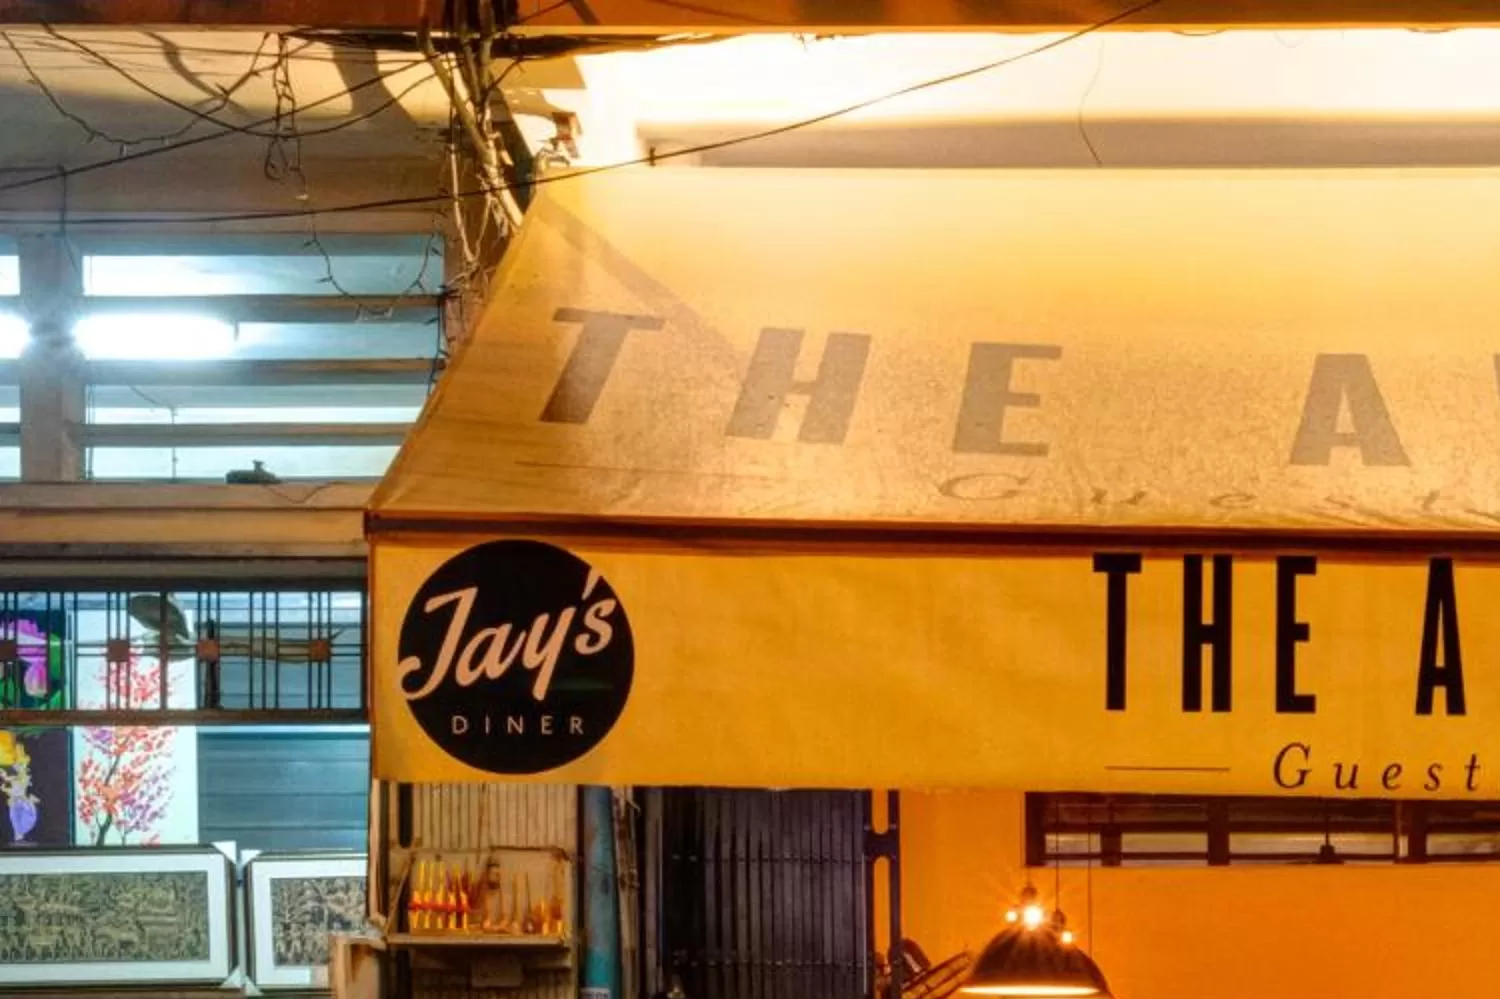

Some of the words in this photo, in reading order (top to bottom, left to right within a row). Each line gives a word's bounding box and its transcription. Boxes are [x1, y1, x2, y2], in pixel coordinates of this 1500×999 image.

[540, 307, 1063, 457] THE
[399, 566, 617, 701] Jay's
[1093, 553, 1318, 713] THE
[452, 715, 584, 735] DINER
